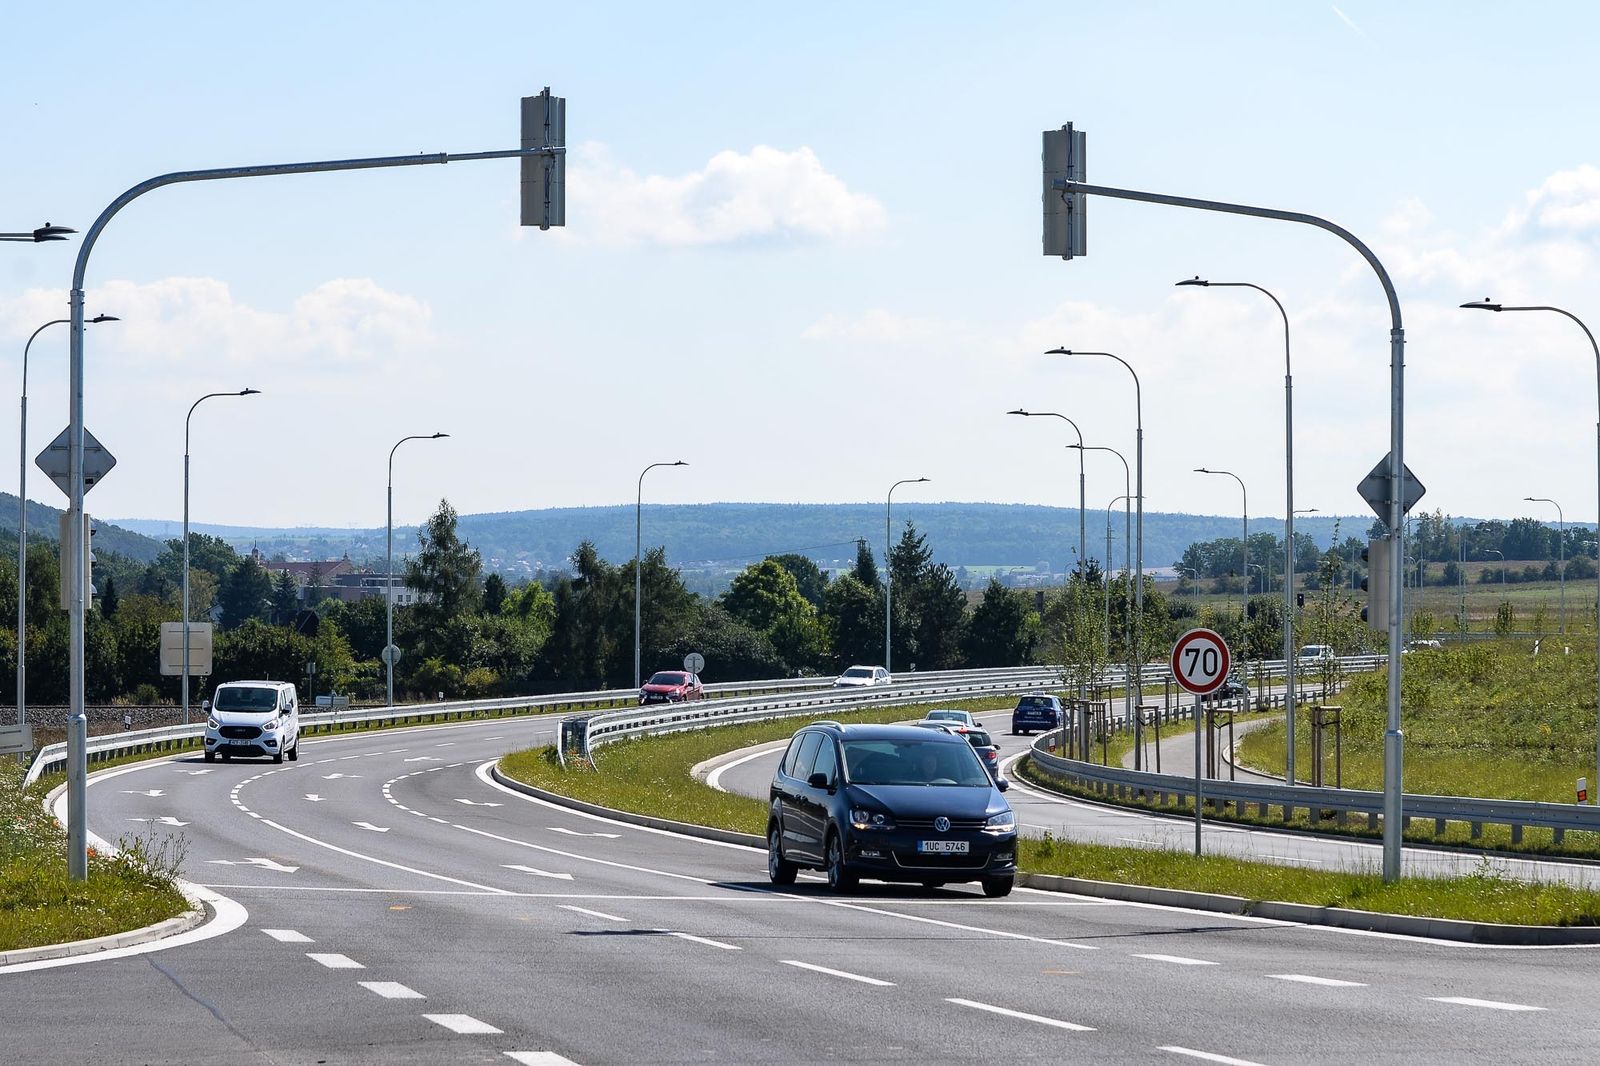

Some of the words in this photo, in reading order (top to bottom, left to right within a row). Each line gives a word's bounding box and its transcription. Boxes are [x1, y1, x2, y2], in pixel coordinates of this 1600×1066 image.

[1185, 647, 1218, 677] 70
[925, 841, 940, 851] 1UC
[945, 842, 966, 851] 5746
